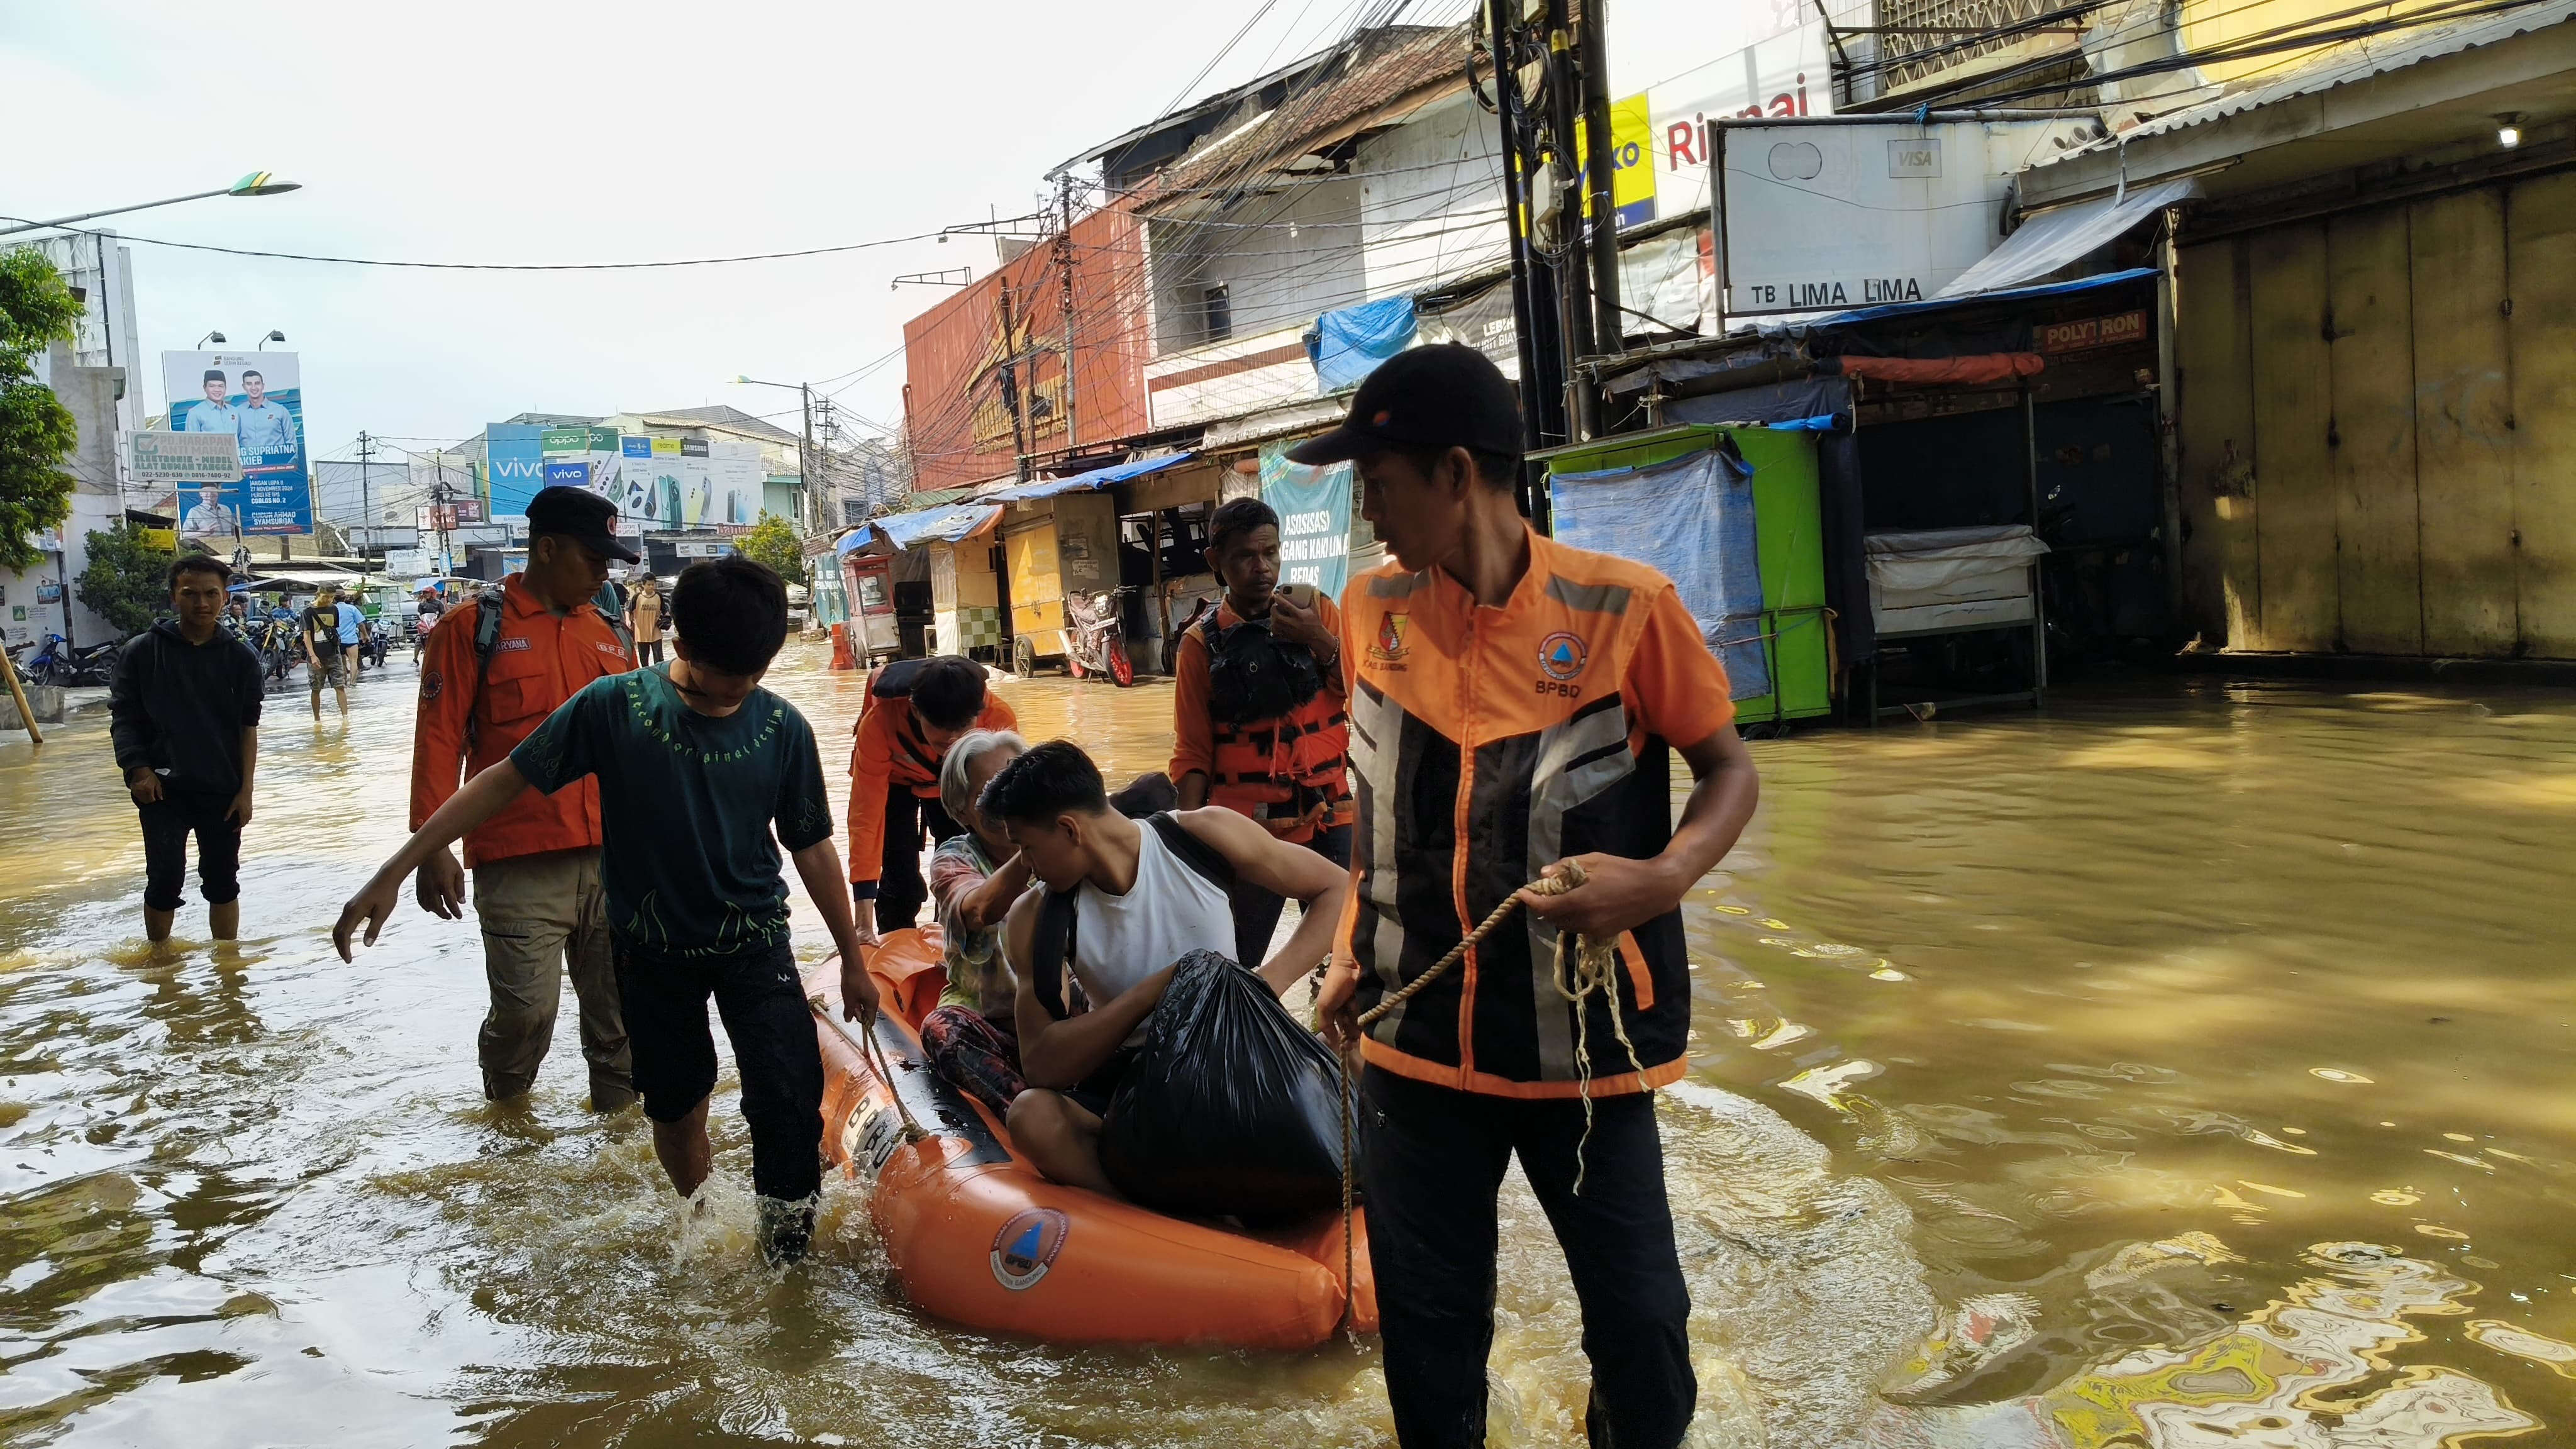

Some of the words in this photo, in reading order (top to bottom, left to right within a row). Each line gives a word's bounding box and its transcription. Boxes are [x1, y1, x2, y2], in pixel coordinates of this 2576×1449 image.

[1667, 72, 1809, 172] Riai
[1899, 151, 1931, 166] VISA
[1752, 286, 1775, 303] TB
[1789, 282, 1847, 307] LIMA
[1864, 278, 1923, 302] LIMA
[1483, 316, 1515, 336] LEBIH
[2047, 313, 2139, 345] POLYTRON
[1499, 331, 1518, 346] BIAY
[550, 436, 579, 445] oppo
[684, 443, 708, 452] SAMSUNG
[162, 446, 188, 454] ANTI
[192, 446, 232, 455] MAHAL
[248, 444, 296, 456] SUPRIATNA
[238, 456, 263, 465] AKIEB
[553, 469, 582, 479] vivo
[1284, 510, 1330, 535] ASOSISASI
[1280, 539, 1307, 561] GANG
[1309, 536, 1328, 560] KAKI
[1535, 680, 1582, 698] BPBD
